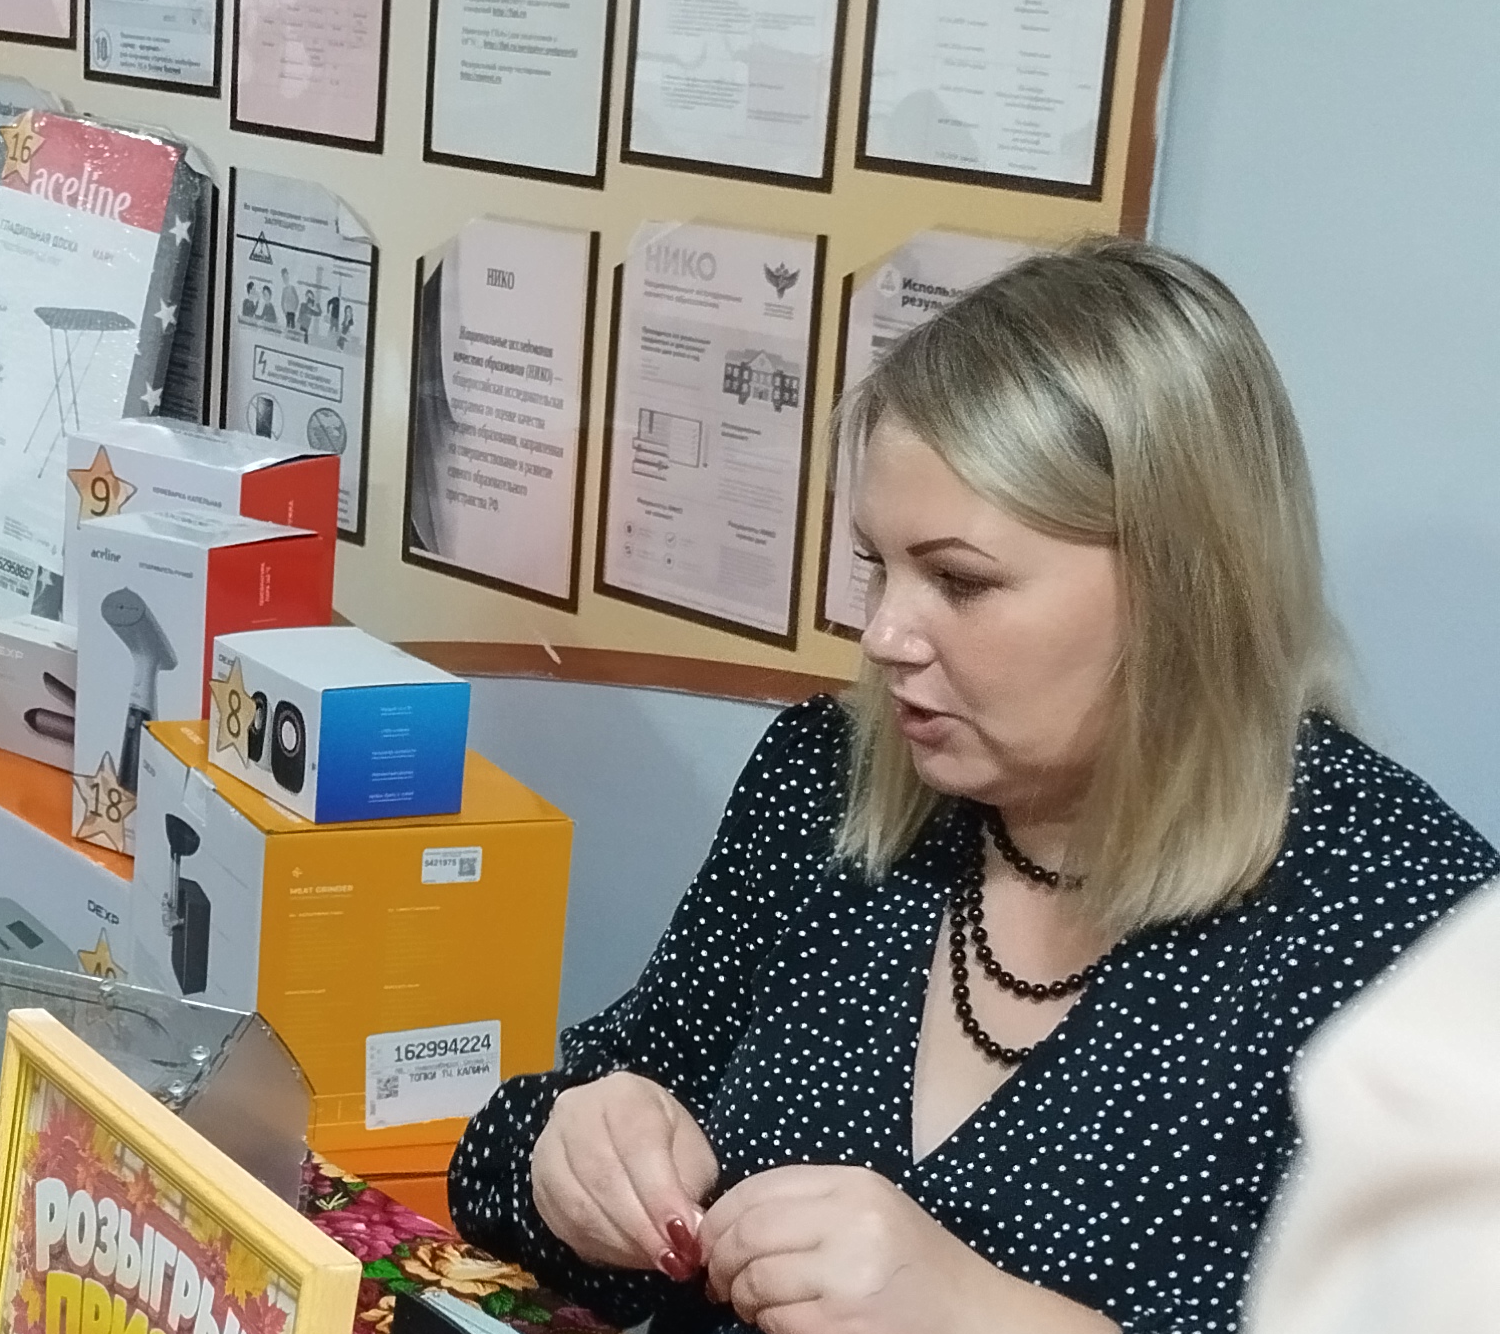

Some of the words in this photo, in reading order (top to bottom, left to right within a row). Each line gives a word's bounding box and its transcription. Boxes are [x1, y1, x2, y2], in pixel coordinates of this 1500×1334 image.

[8, 132, 34, 164] 16
[30, 162, 132, 223] aceline
[645, 244, 717, 282] НИКО
[486, 267, 515, 290] НИКО
[902, 276, 963, 298] Использо
[901, 295, 943, 312] резул
[90, 476, 111, 518] 9
[90, 547, 122, 563] aceline
[226, 689, 242, 739] 8
[88, 782, 123, 824] 18
[290, 886, 314, 895] MEAT
[88, 899, 120, 925] DEXP
[394, 1033, 492, 1063] 162994224
